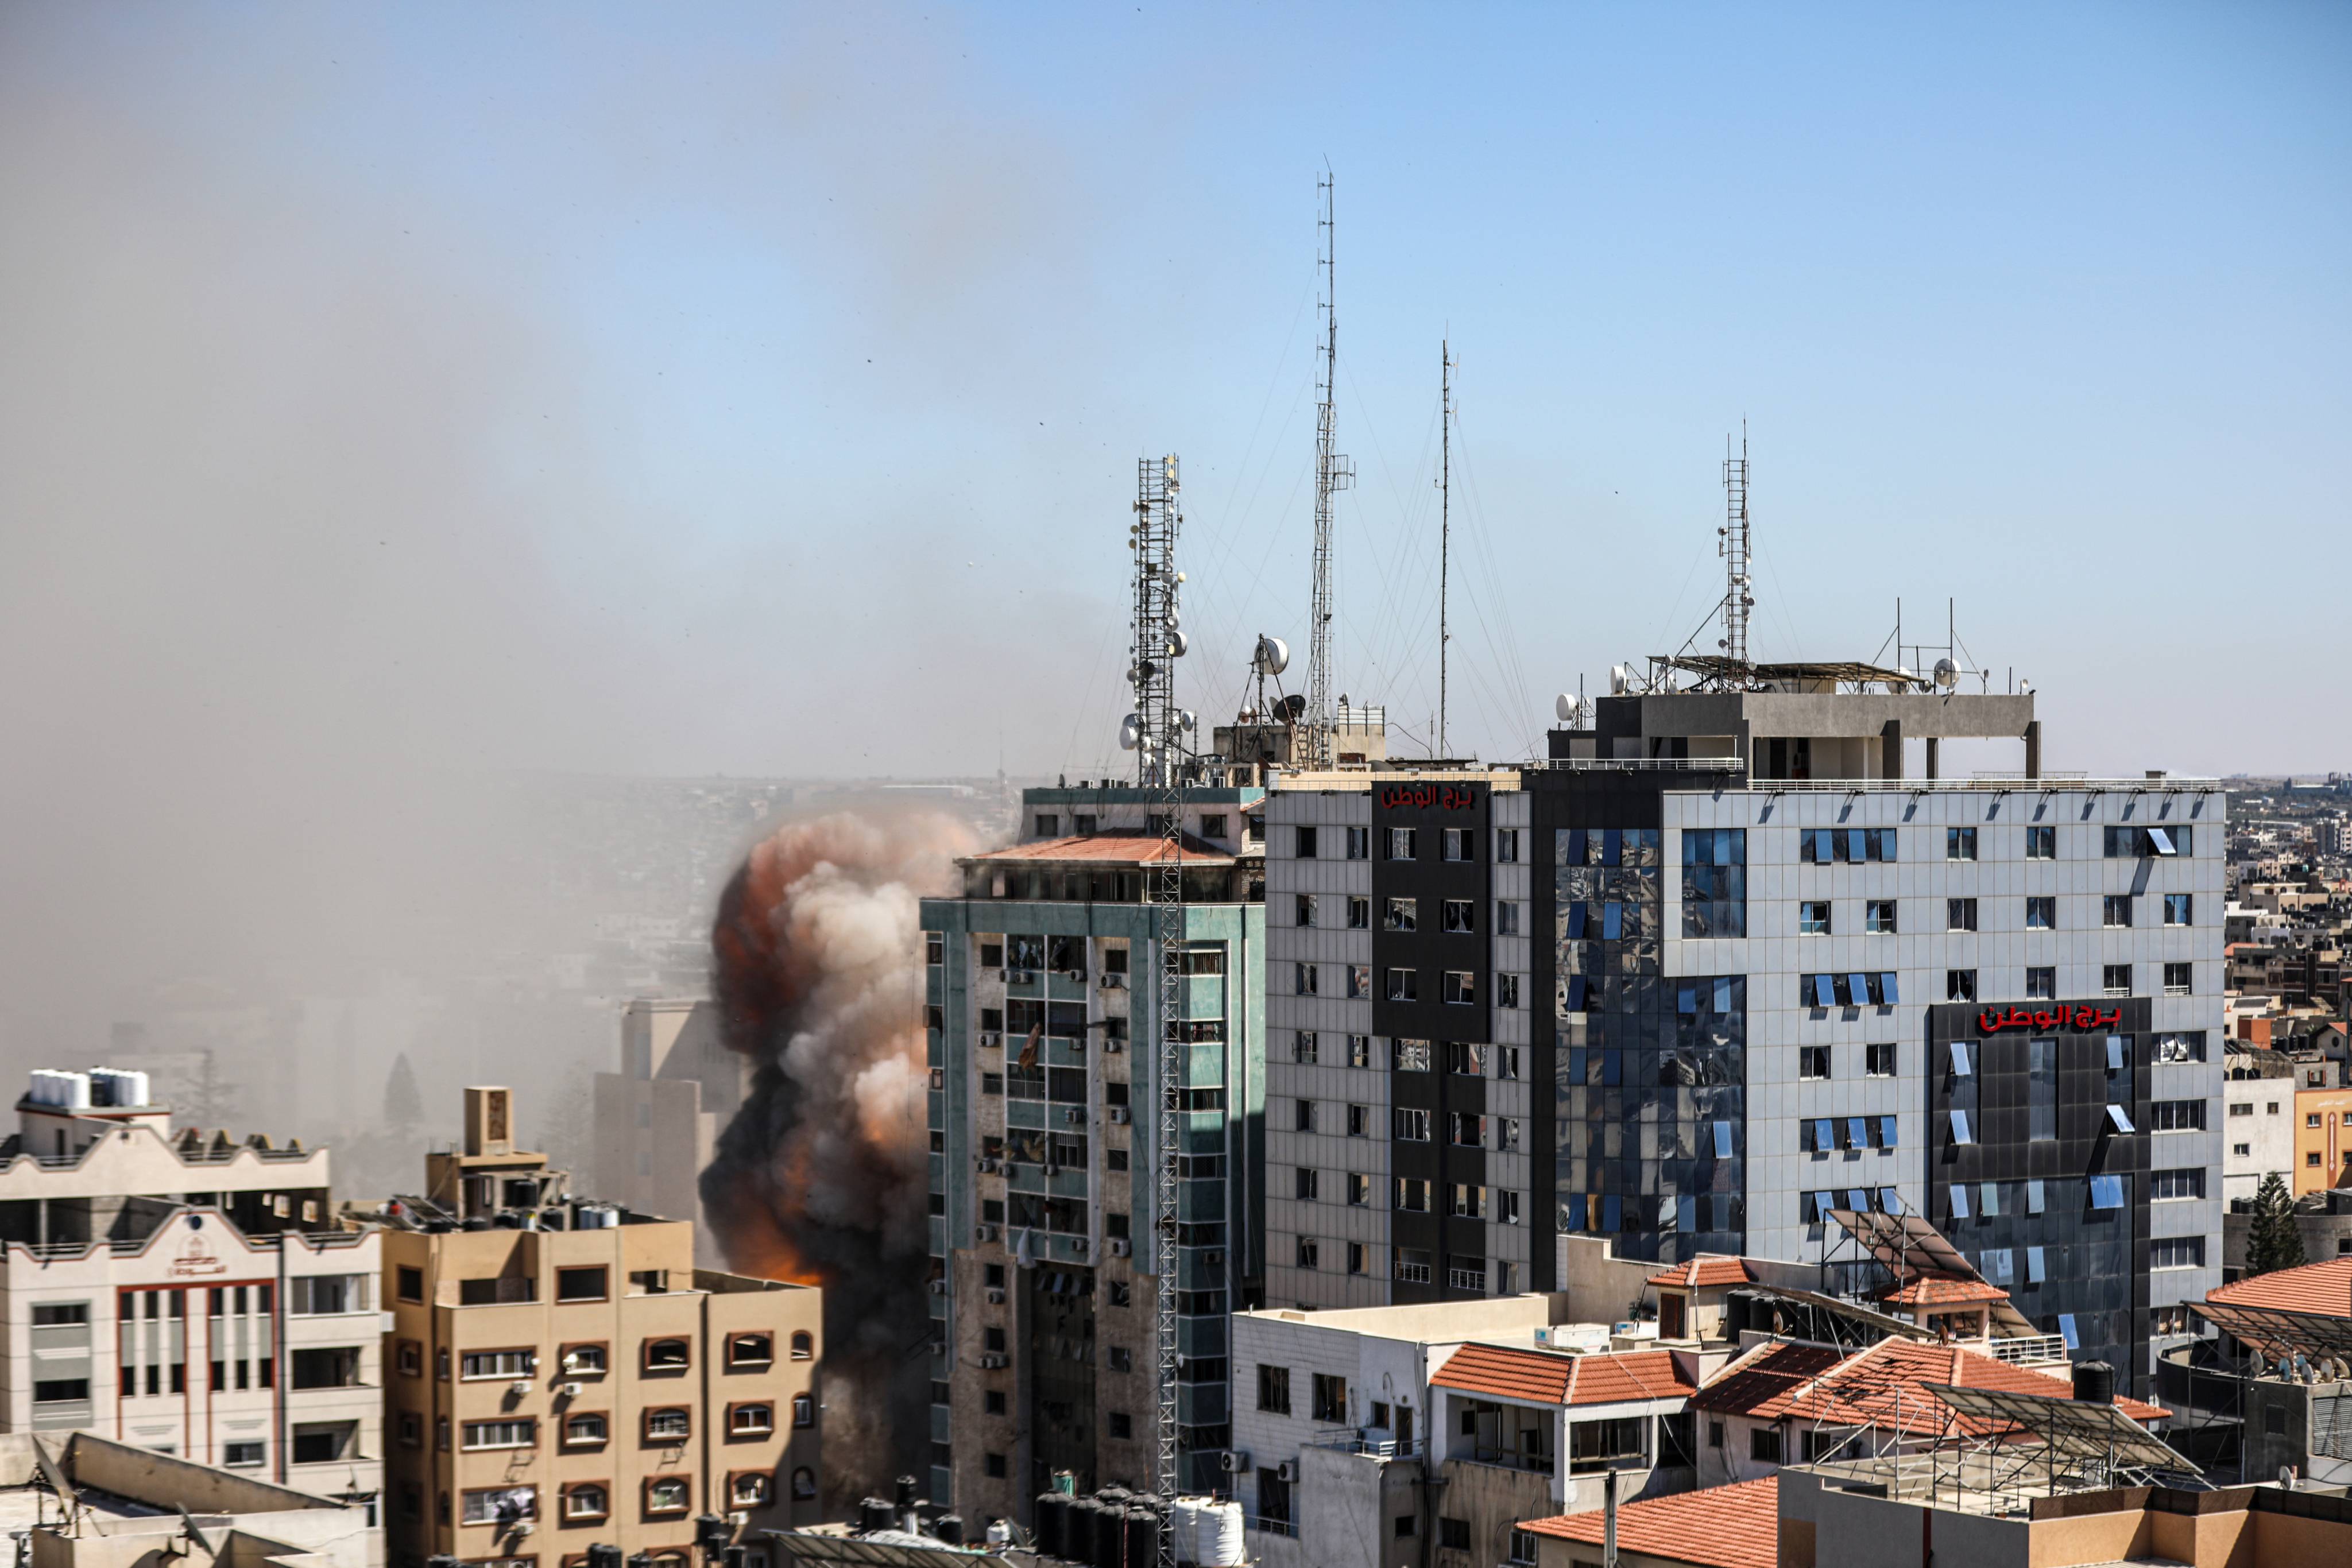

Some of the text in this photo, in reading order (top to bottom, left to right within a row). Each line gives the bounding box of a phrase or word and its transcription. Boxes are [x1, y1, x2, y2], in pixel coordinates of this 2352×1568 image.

[1380, 785, 1471, 810] برج الوطن
[1979, 1004, 2122, 1032] برج الوطن
